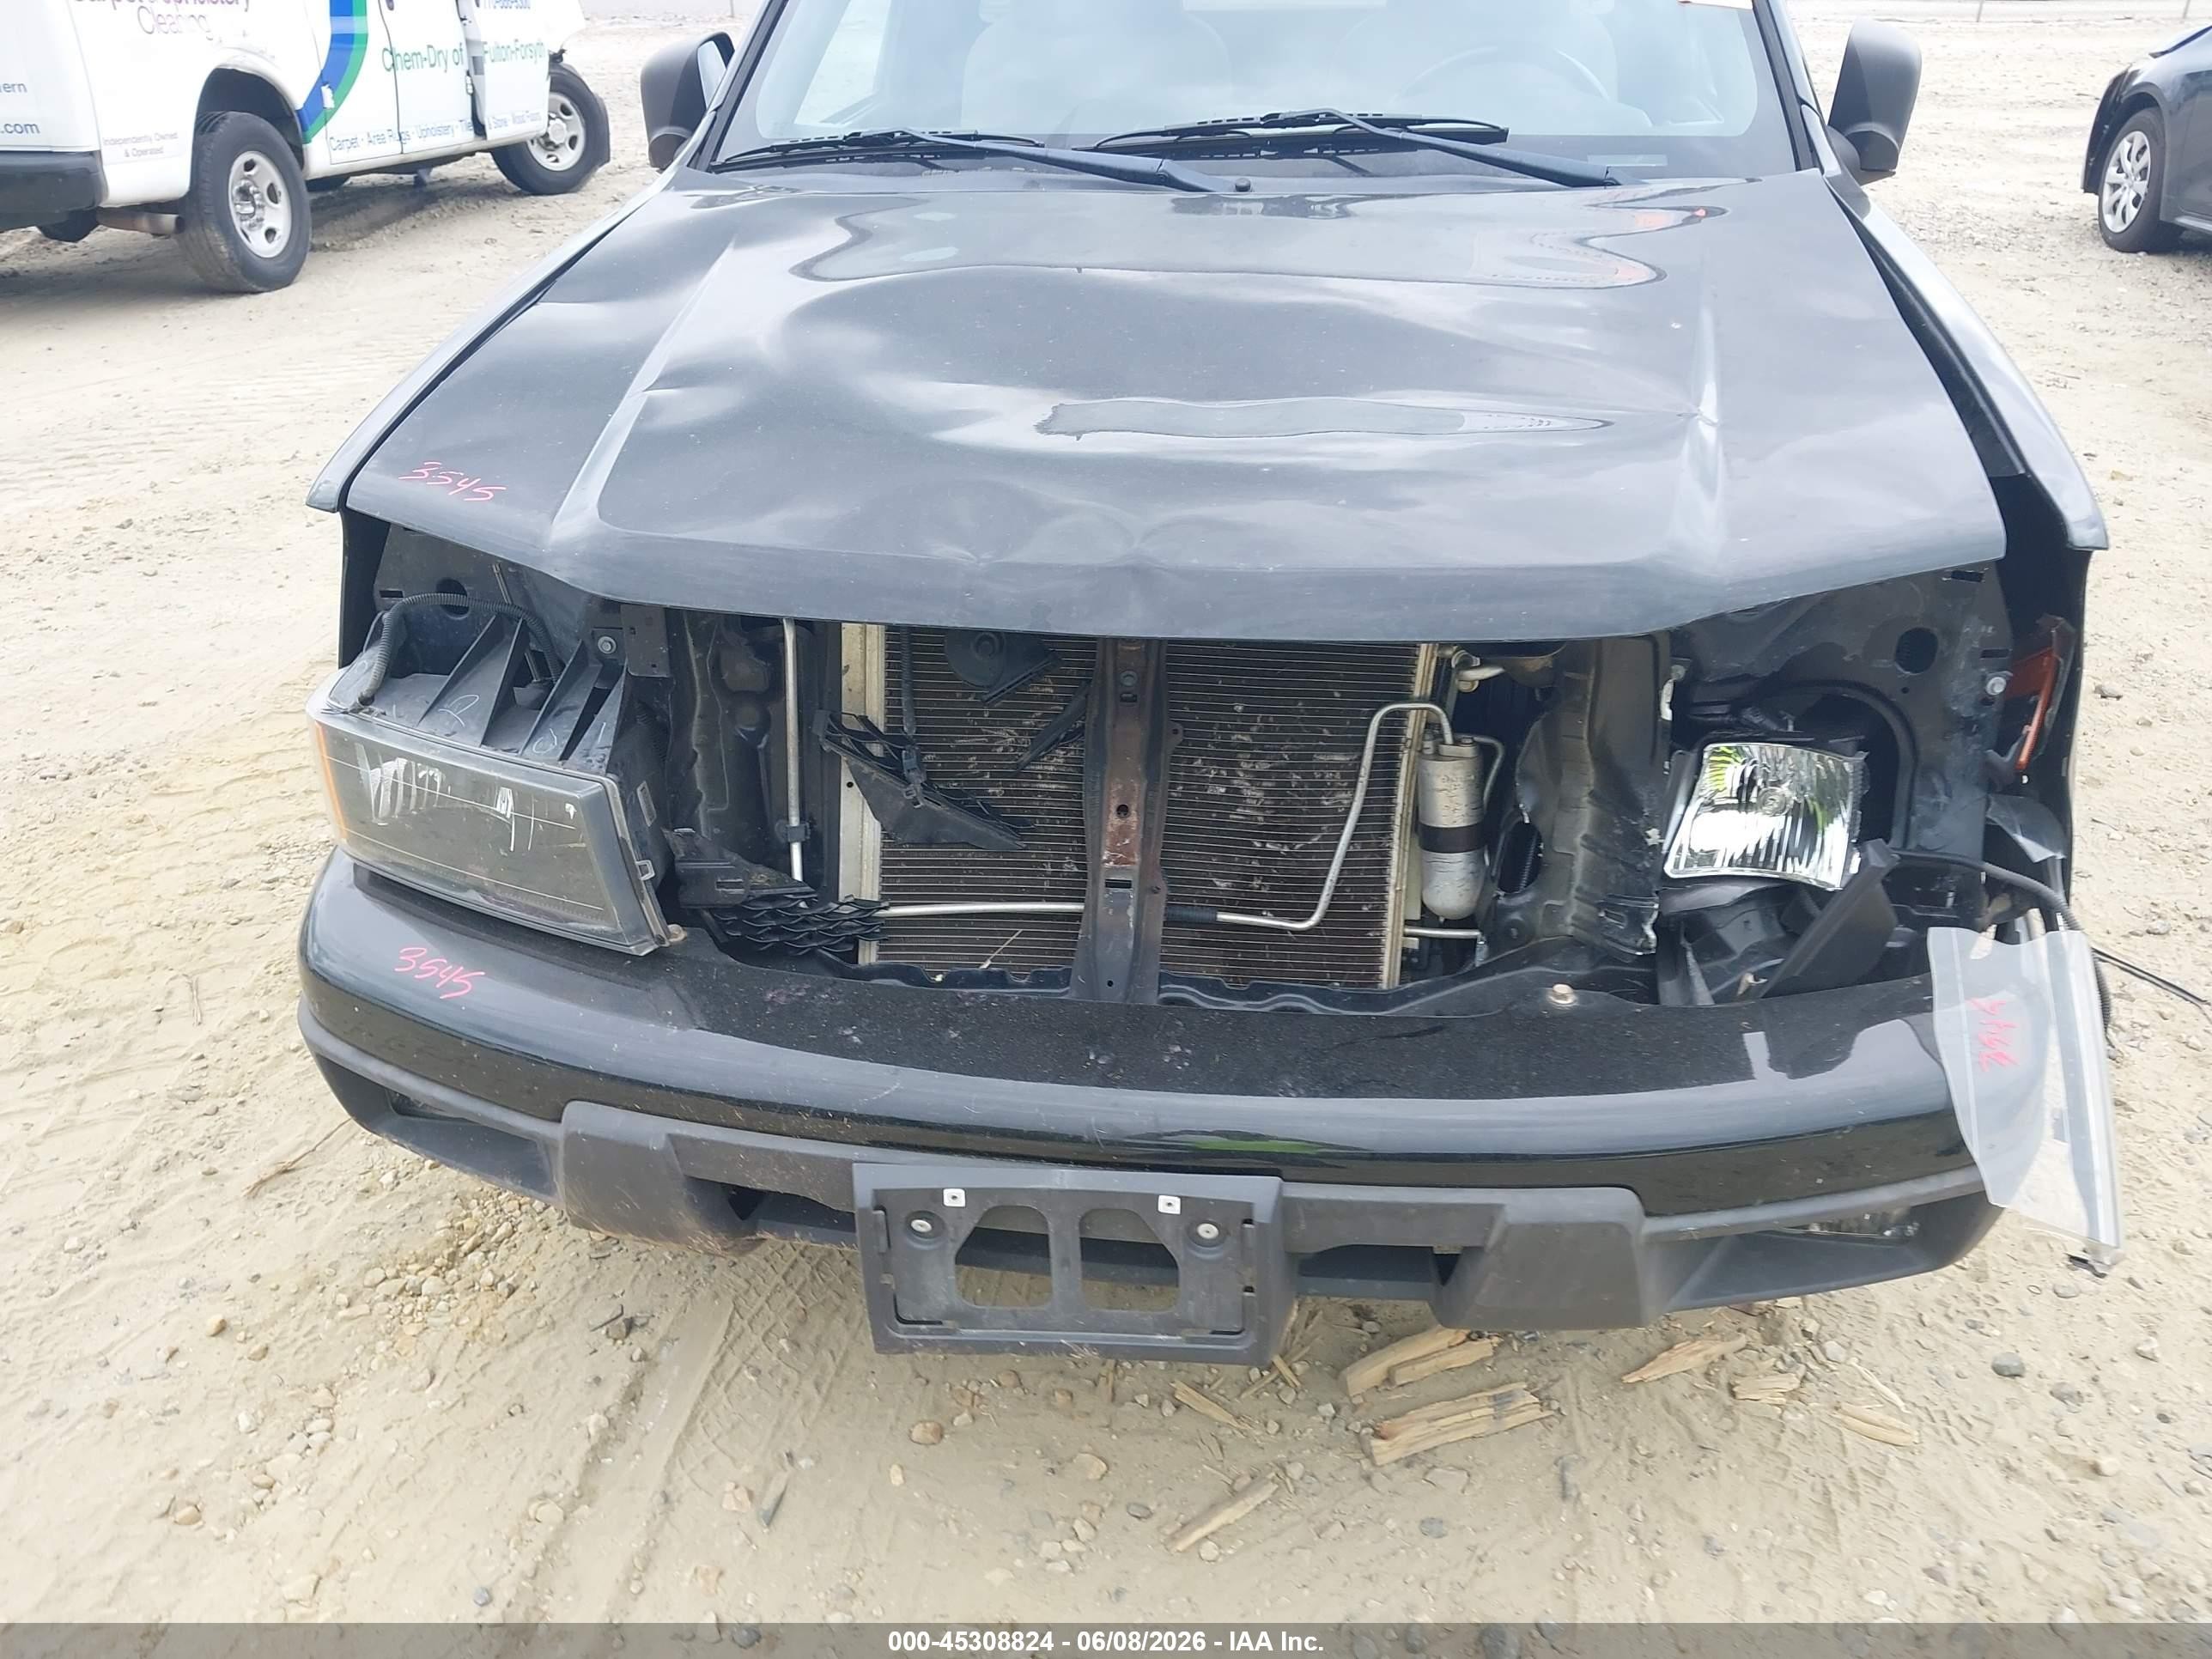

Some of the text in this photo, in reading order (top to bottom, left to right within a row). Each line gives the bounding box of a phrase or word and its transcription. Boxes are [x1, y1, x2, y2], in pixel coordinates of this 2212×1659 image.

[381, 45, 448, 73] Chem-Dry
[453, 42, 464, 66] of
[0, 82, 27, 94] ern
[329, 136, 359, 153] Carpet
[368, 131, 386, 146] Area
[387, 128, 411, 145] Rugs
[393, 946, 486, 1000] 3545
